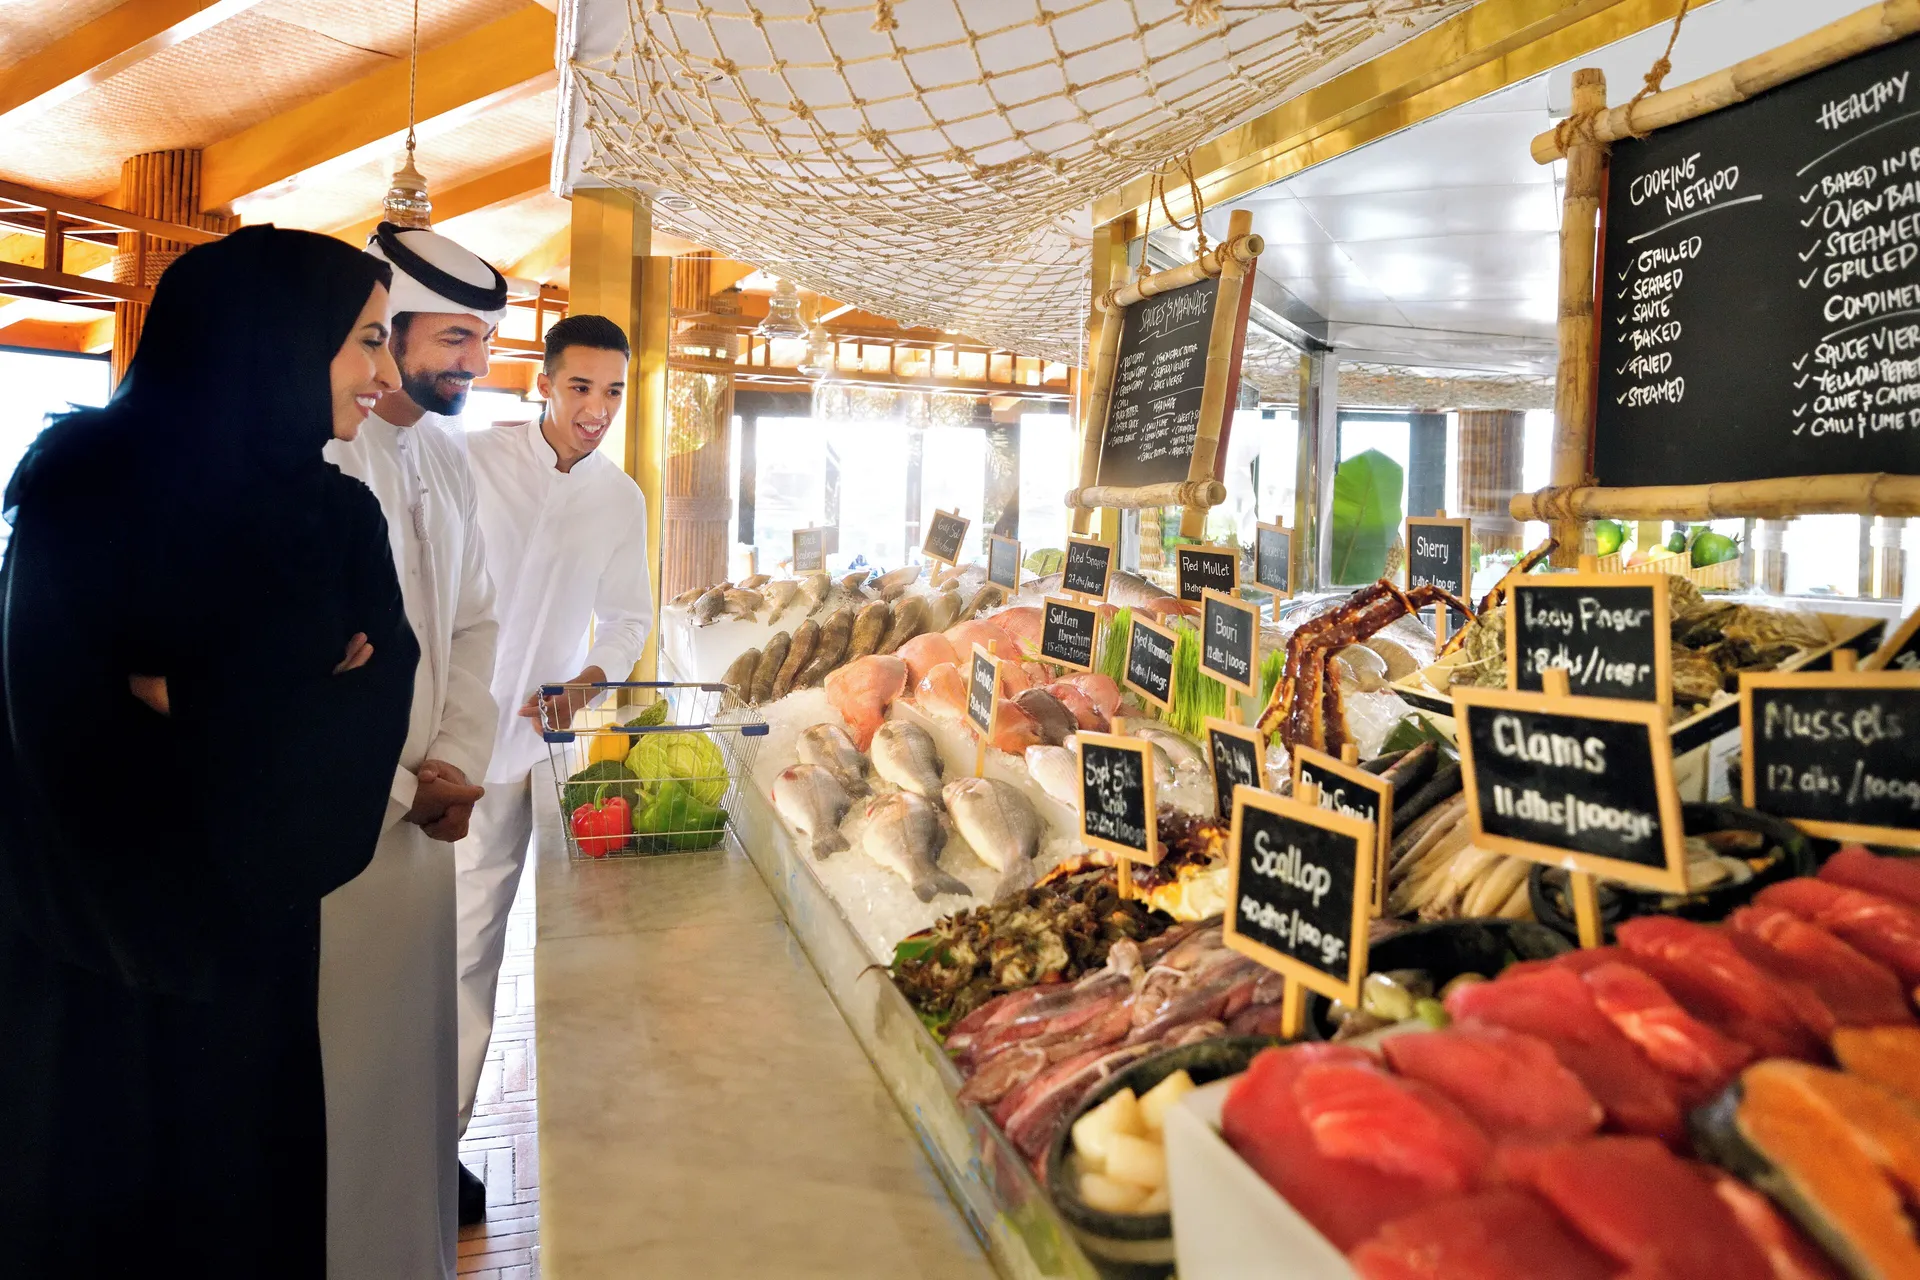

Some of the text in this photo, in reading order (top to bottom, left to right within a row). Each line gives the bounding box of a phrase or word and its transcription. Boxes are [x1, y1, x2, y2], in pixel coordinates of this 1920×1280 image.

[1816, 71, 1909, 130] HEALTHY
[1630, 152, 1701, 206] COOKING
[1665, 165, 1739, 216] METHOD
[1821, 165, 1877, 199] BAKED
[1882, 150, 1907, 176] IN
[1823, 195, 1883, 229] OVEN
[1637, 235, 1702, 273] GRILLED
[1823, 243, 1918, 288] GRILLED
[1632, 268, 1683, 301] SEARED
[1139, 302, 1167, 332] SAUCES
[1172, 290, 1213, 323] MARINADE
[1629, 320, 1682, 351] BAKED
[1629, 351, 1672, 379] FRIED
[1815, 335, 1870, 369] SAUCE
[1628, 376, 1685, 407] STEAMED
[1813, 362, 1880, 394] YELLOW
[1813, 390, 1861, 414] OLIVE
[1811, 416, 1853, 437] CHILI
[1871, 412, 1906, 431] LIME
[1069, 546, 1084, 564] Red
[1416, 535, 1449, 565] Sherry
[1182, 556, 1230, 577] Red Mullet
[1049, 607, 1079, 629] Sultan
[1215, 614, 1238, 644] Bouri
[1058, 628, 1091, 648] Ibrahim
[1133, 627, 1148, 649] Red
[1764, 699, 1903, 747] Mussels
[1492, 714, 1607, 775] Clams
[1250, 829, 1332, 909] Scallop
